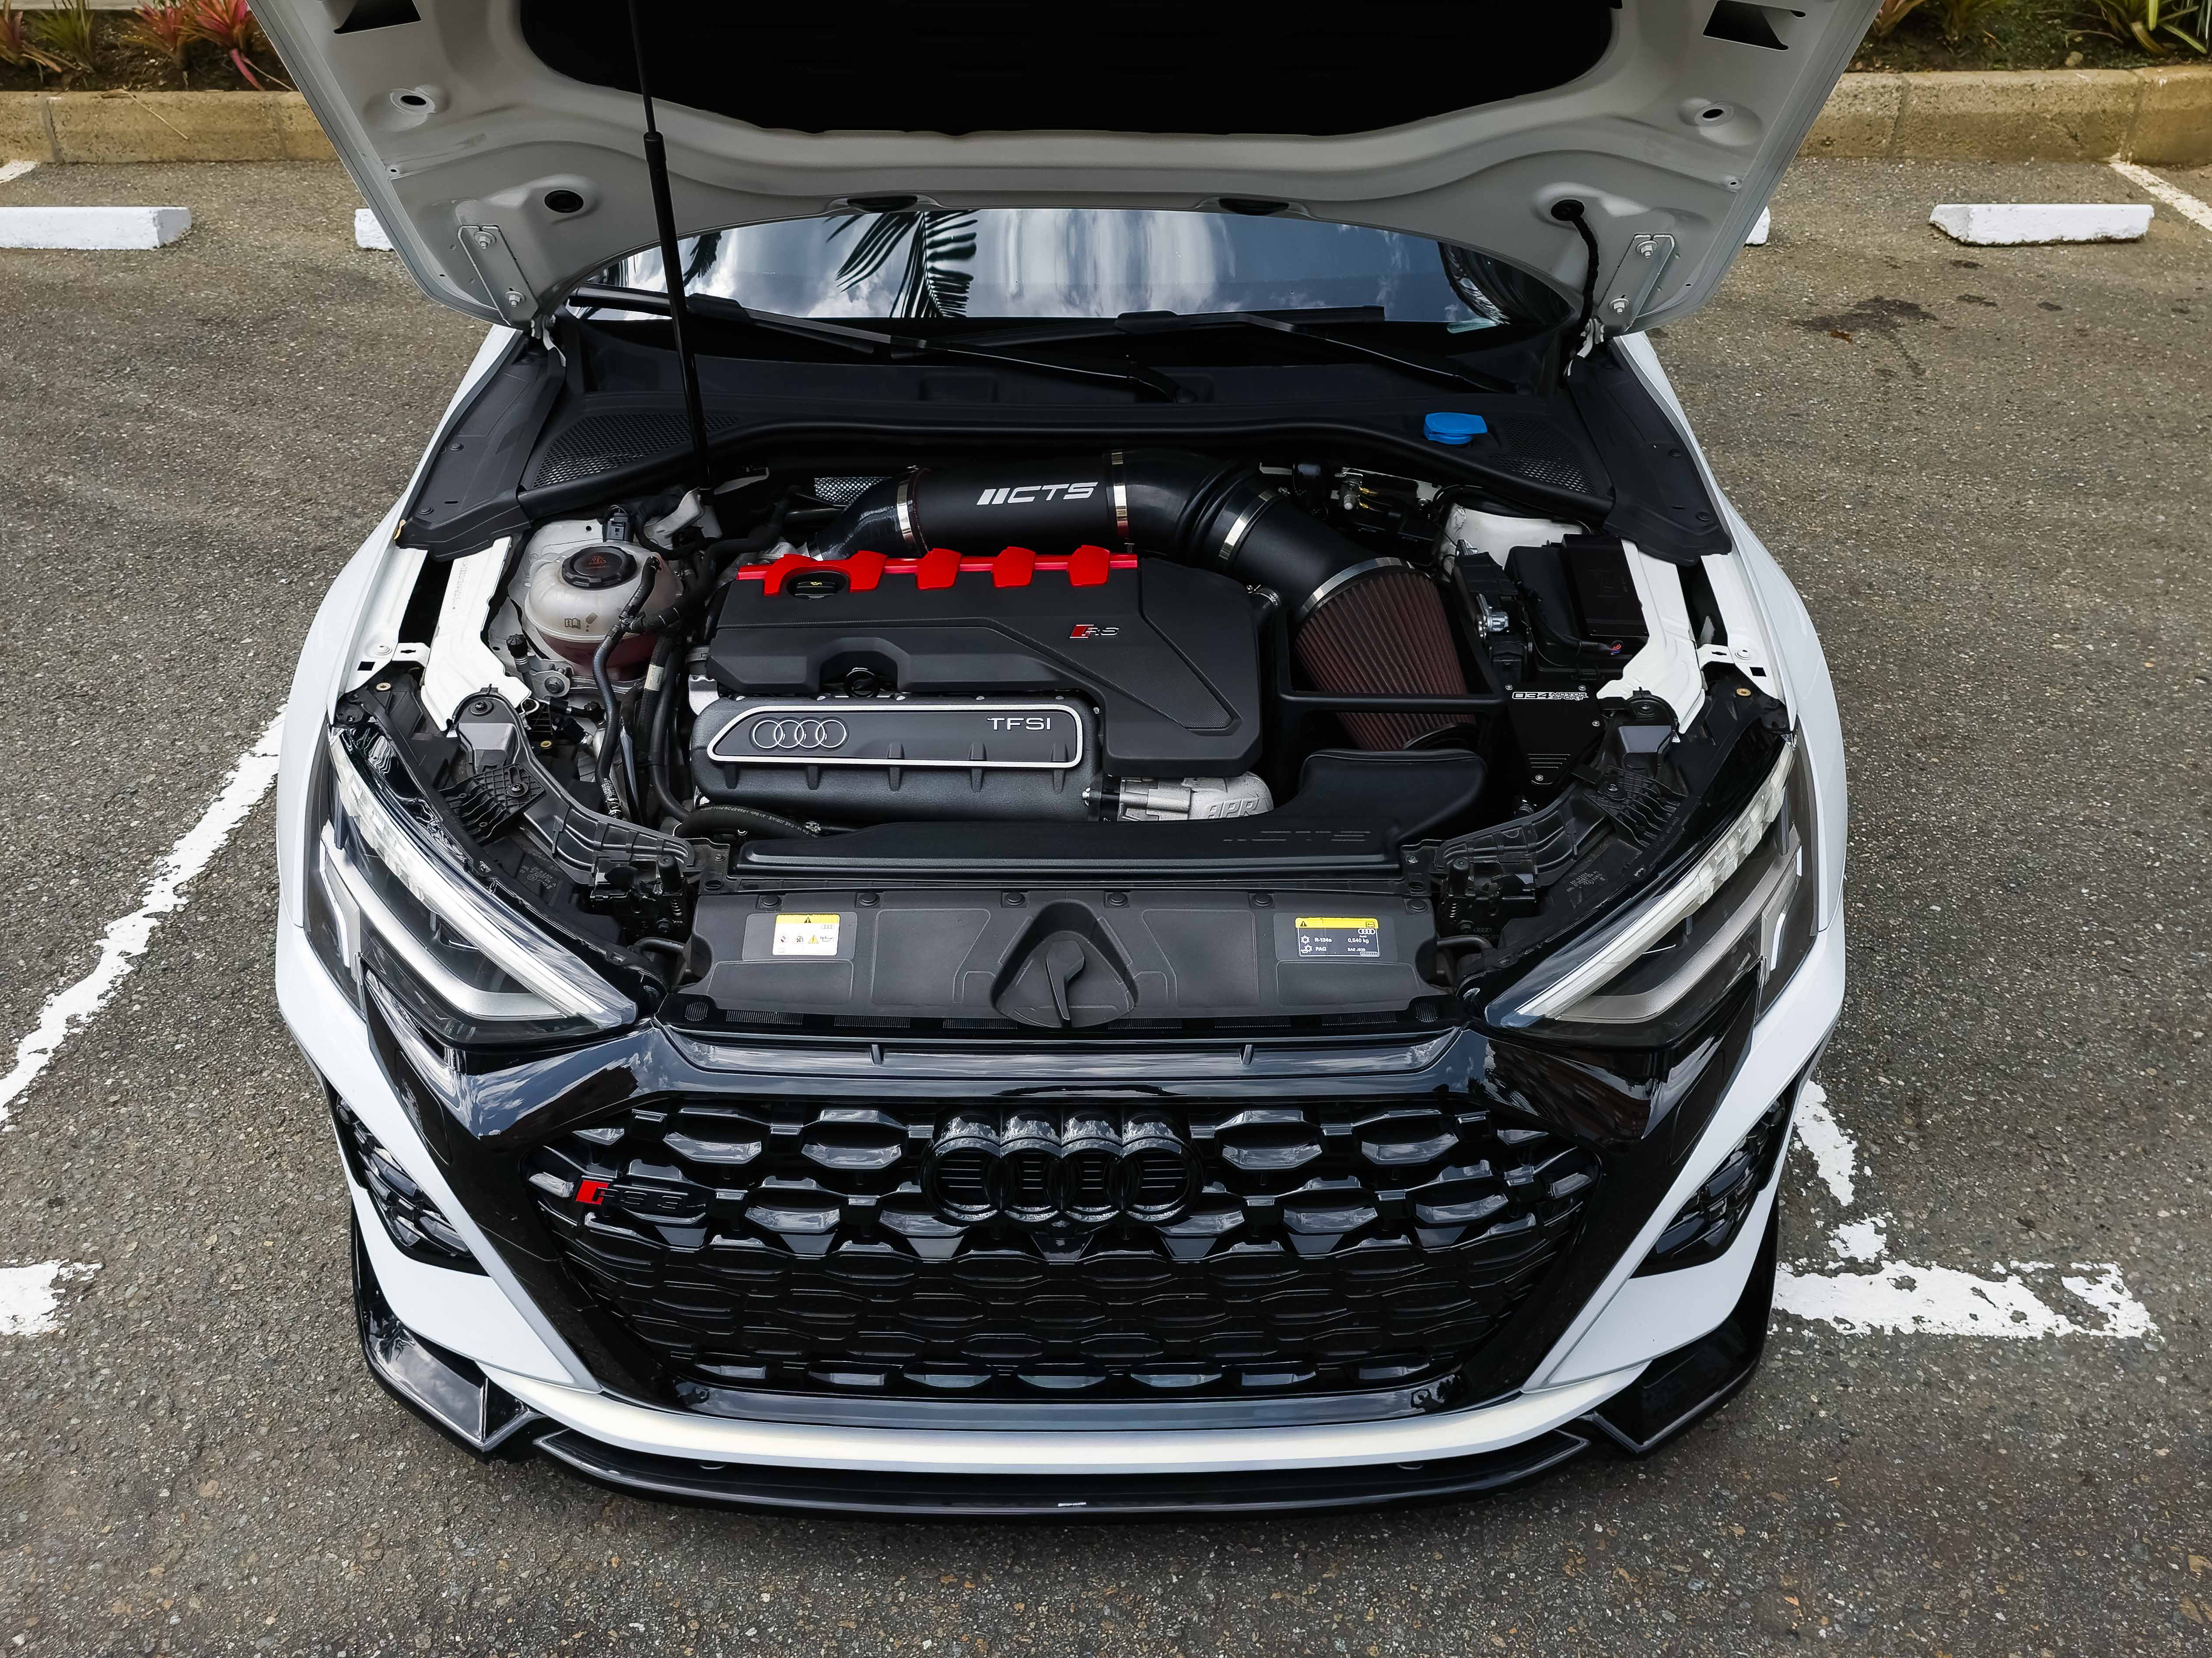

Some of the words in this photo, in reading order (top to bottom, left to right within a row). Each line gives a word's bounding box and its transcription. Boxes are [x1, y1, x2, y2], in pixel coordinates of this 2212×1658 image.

[1080, 626, 1120, 637] RS
[987, 717, 1051, 731] TFSI
[1208, 798, 1260, 819] APR
